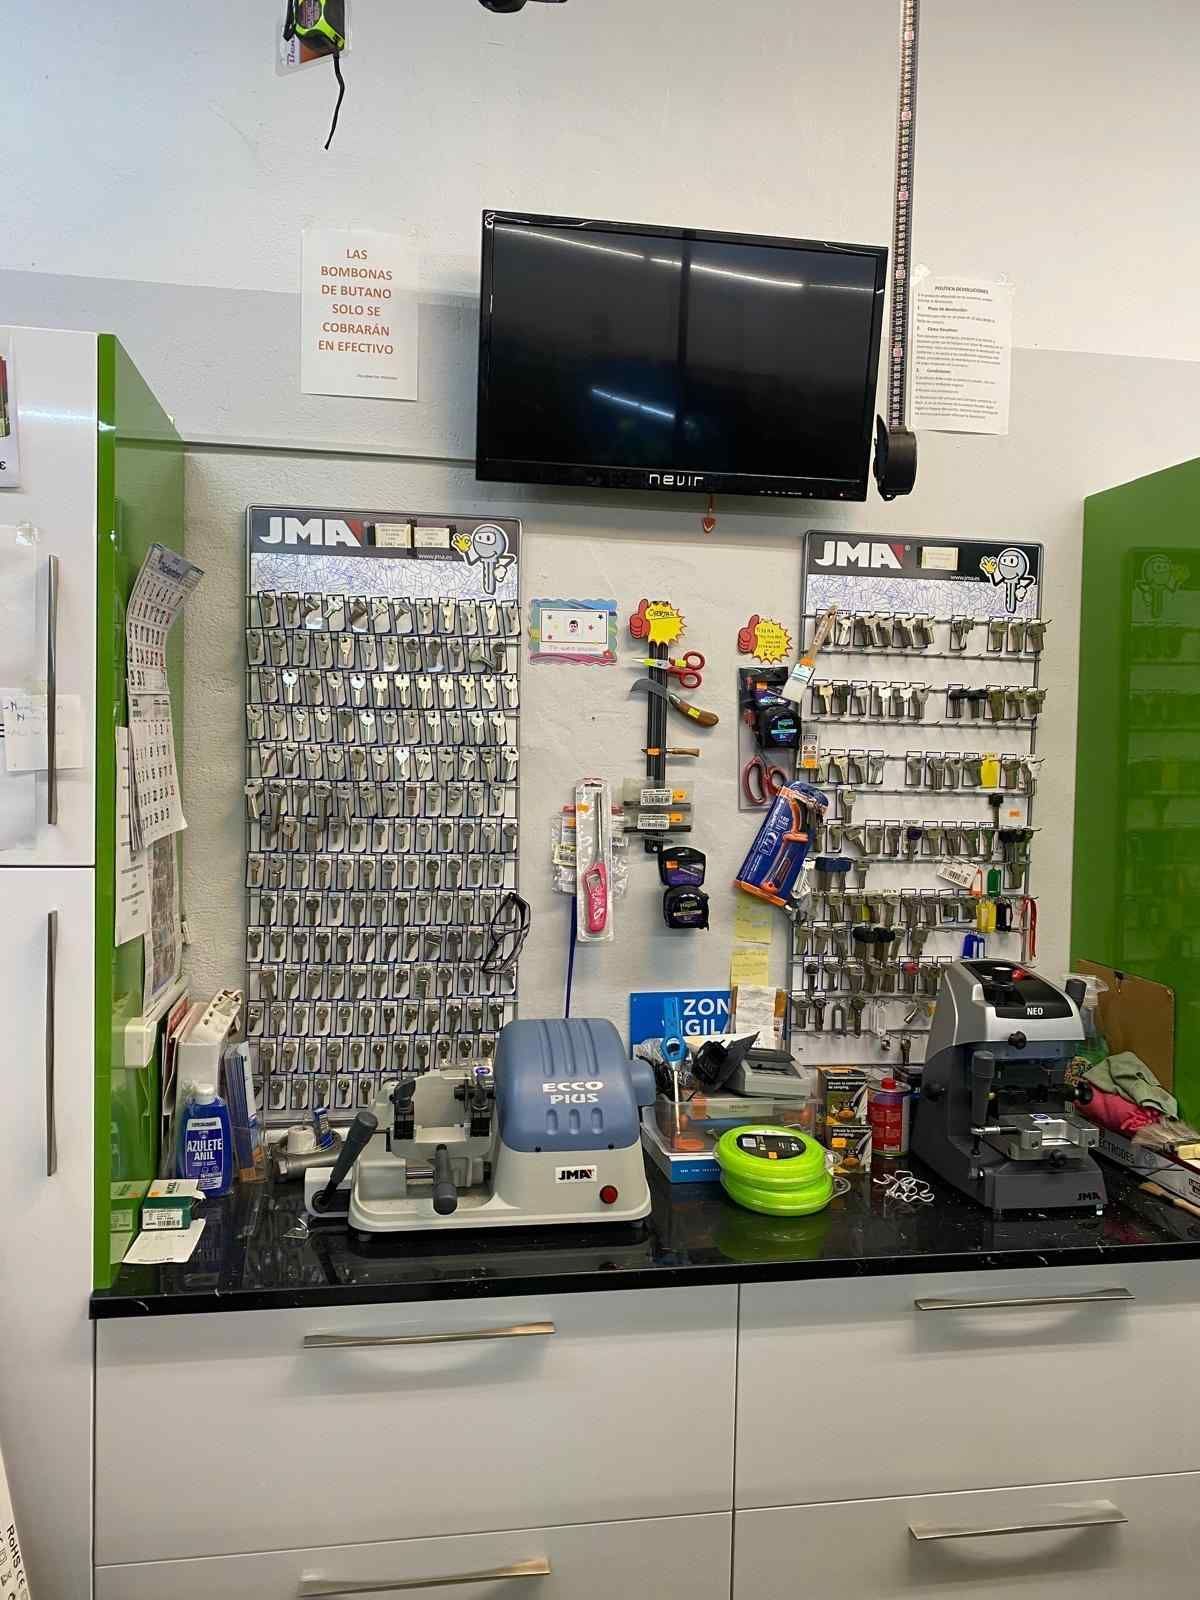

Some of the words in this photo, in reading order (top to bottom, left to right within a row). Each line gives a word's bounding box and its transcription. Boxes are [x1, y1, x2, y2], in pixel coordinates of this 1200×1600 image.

[346, 248, 368, 260] LAS
[320, 265, 393, 280] BOMBONAS
[321, 284, 337, 295] DE
[340, 285, 392, 299] BUTANO
[332, 303, 364, 316] SOLO
[367, 306, 381, 317] SE
[322, 320, 390, 337] COBRARÁN
[318, 340, 334, 351] EN
[338, 341, 394, 355] EFECTIVO
[649, 473, 704, 487] nevir
[258, 516, 362, 547] JMA
[814, 540, 903, 570] JMA
[1027, 1007, 1043, 1016] NEO
[543, 1081, 604, 1092] ECCO
[186, 1138, 223, 1152] AZULETE
[558, 1168, 592, 1181] JMA
[1076, 1191, 1101, 1201] JMA
[7, 1524, 20, 1568] RoHS
